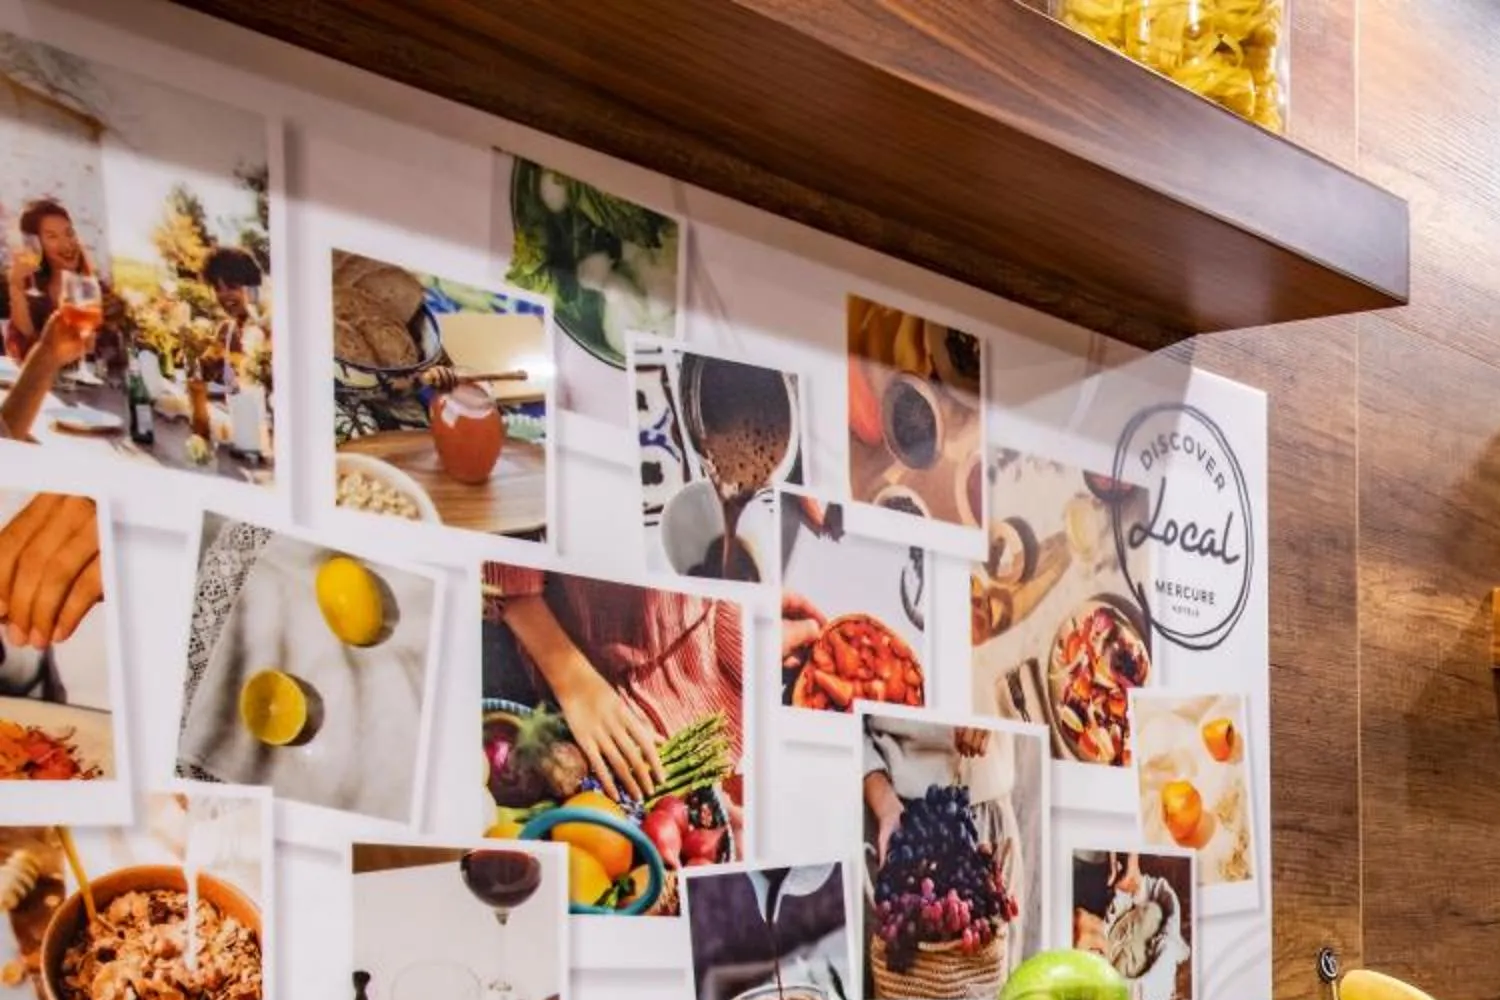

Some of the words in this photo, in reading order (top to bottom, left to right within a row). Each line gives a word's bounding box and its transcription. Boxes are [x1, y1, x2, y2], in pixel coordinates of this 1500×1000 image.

[1140, 432, 1226, 493] DISCOVER
[1128, 476, 1240, 565] Local
[1155, 578, 1217, 606] MERCURE
